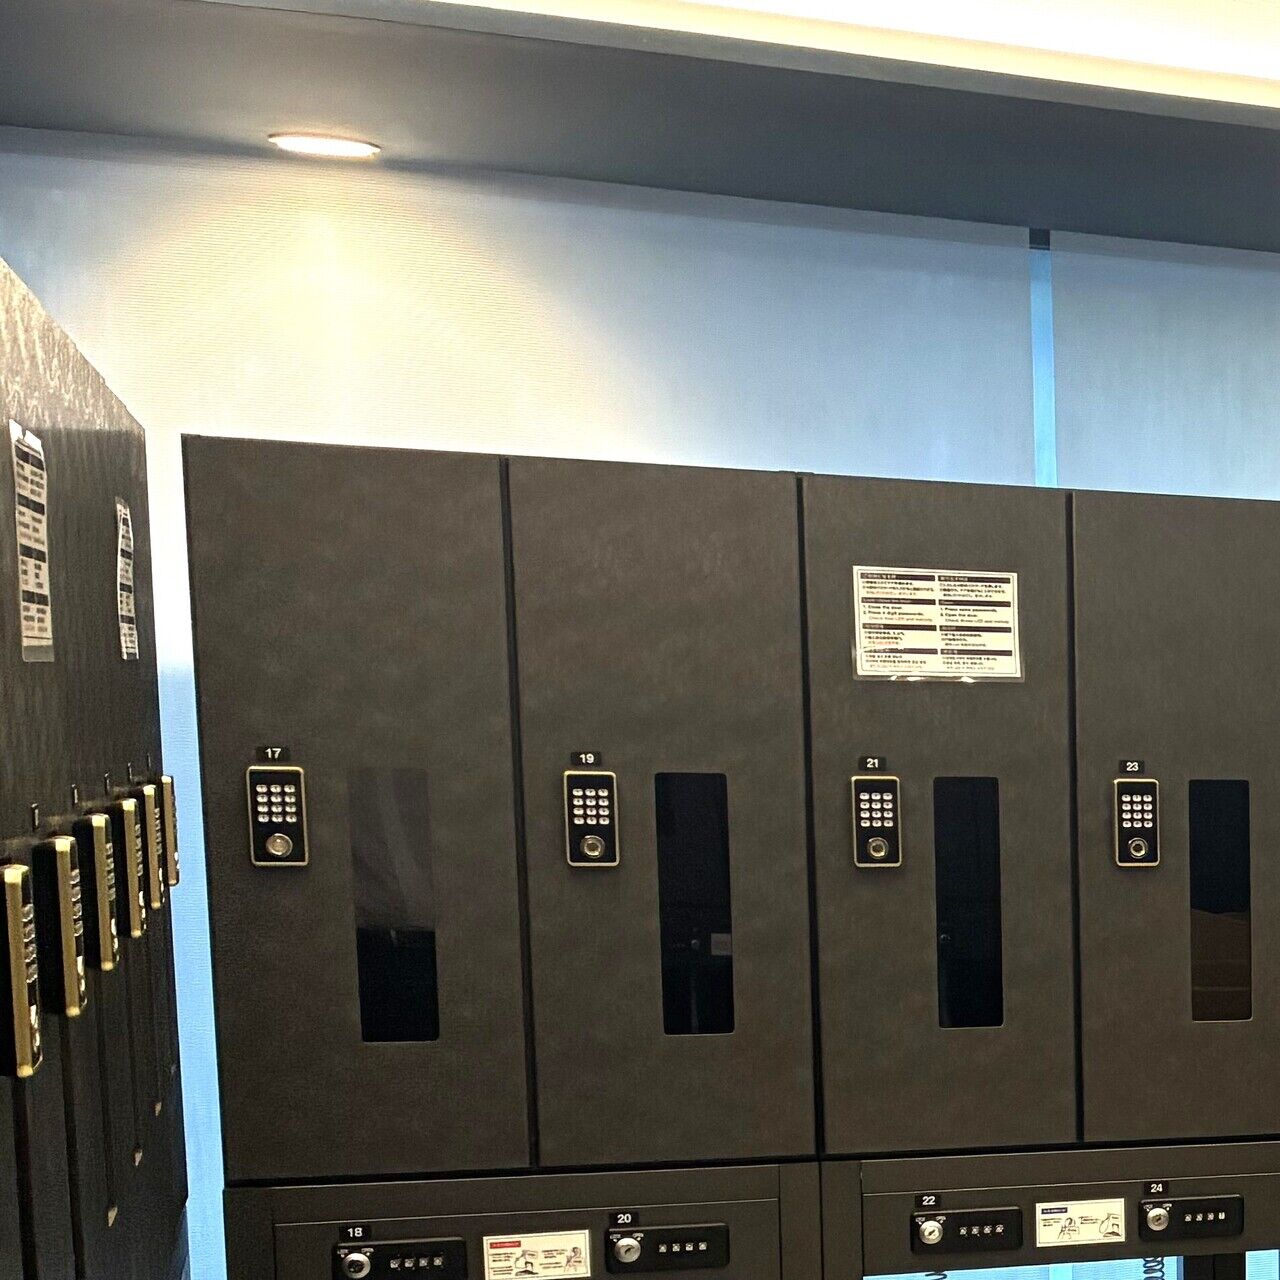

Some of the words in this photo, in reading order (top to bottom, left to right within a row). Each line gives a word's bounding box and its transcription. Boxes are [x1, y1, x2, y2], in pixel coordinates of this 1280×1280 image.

[265, 747, 282, 759] 17
[579, 753, 595, 764] 19
[866, 757, 879, 768] 21
[1126, 761, 1139, 772] 23
[1150, 1183, 1163, 1193] 24
[922, 1195, 936, 1206] 22
[617, 1213, 632, 1224] 20
[347, 1227, 363, 1238] 18
